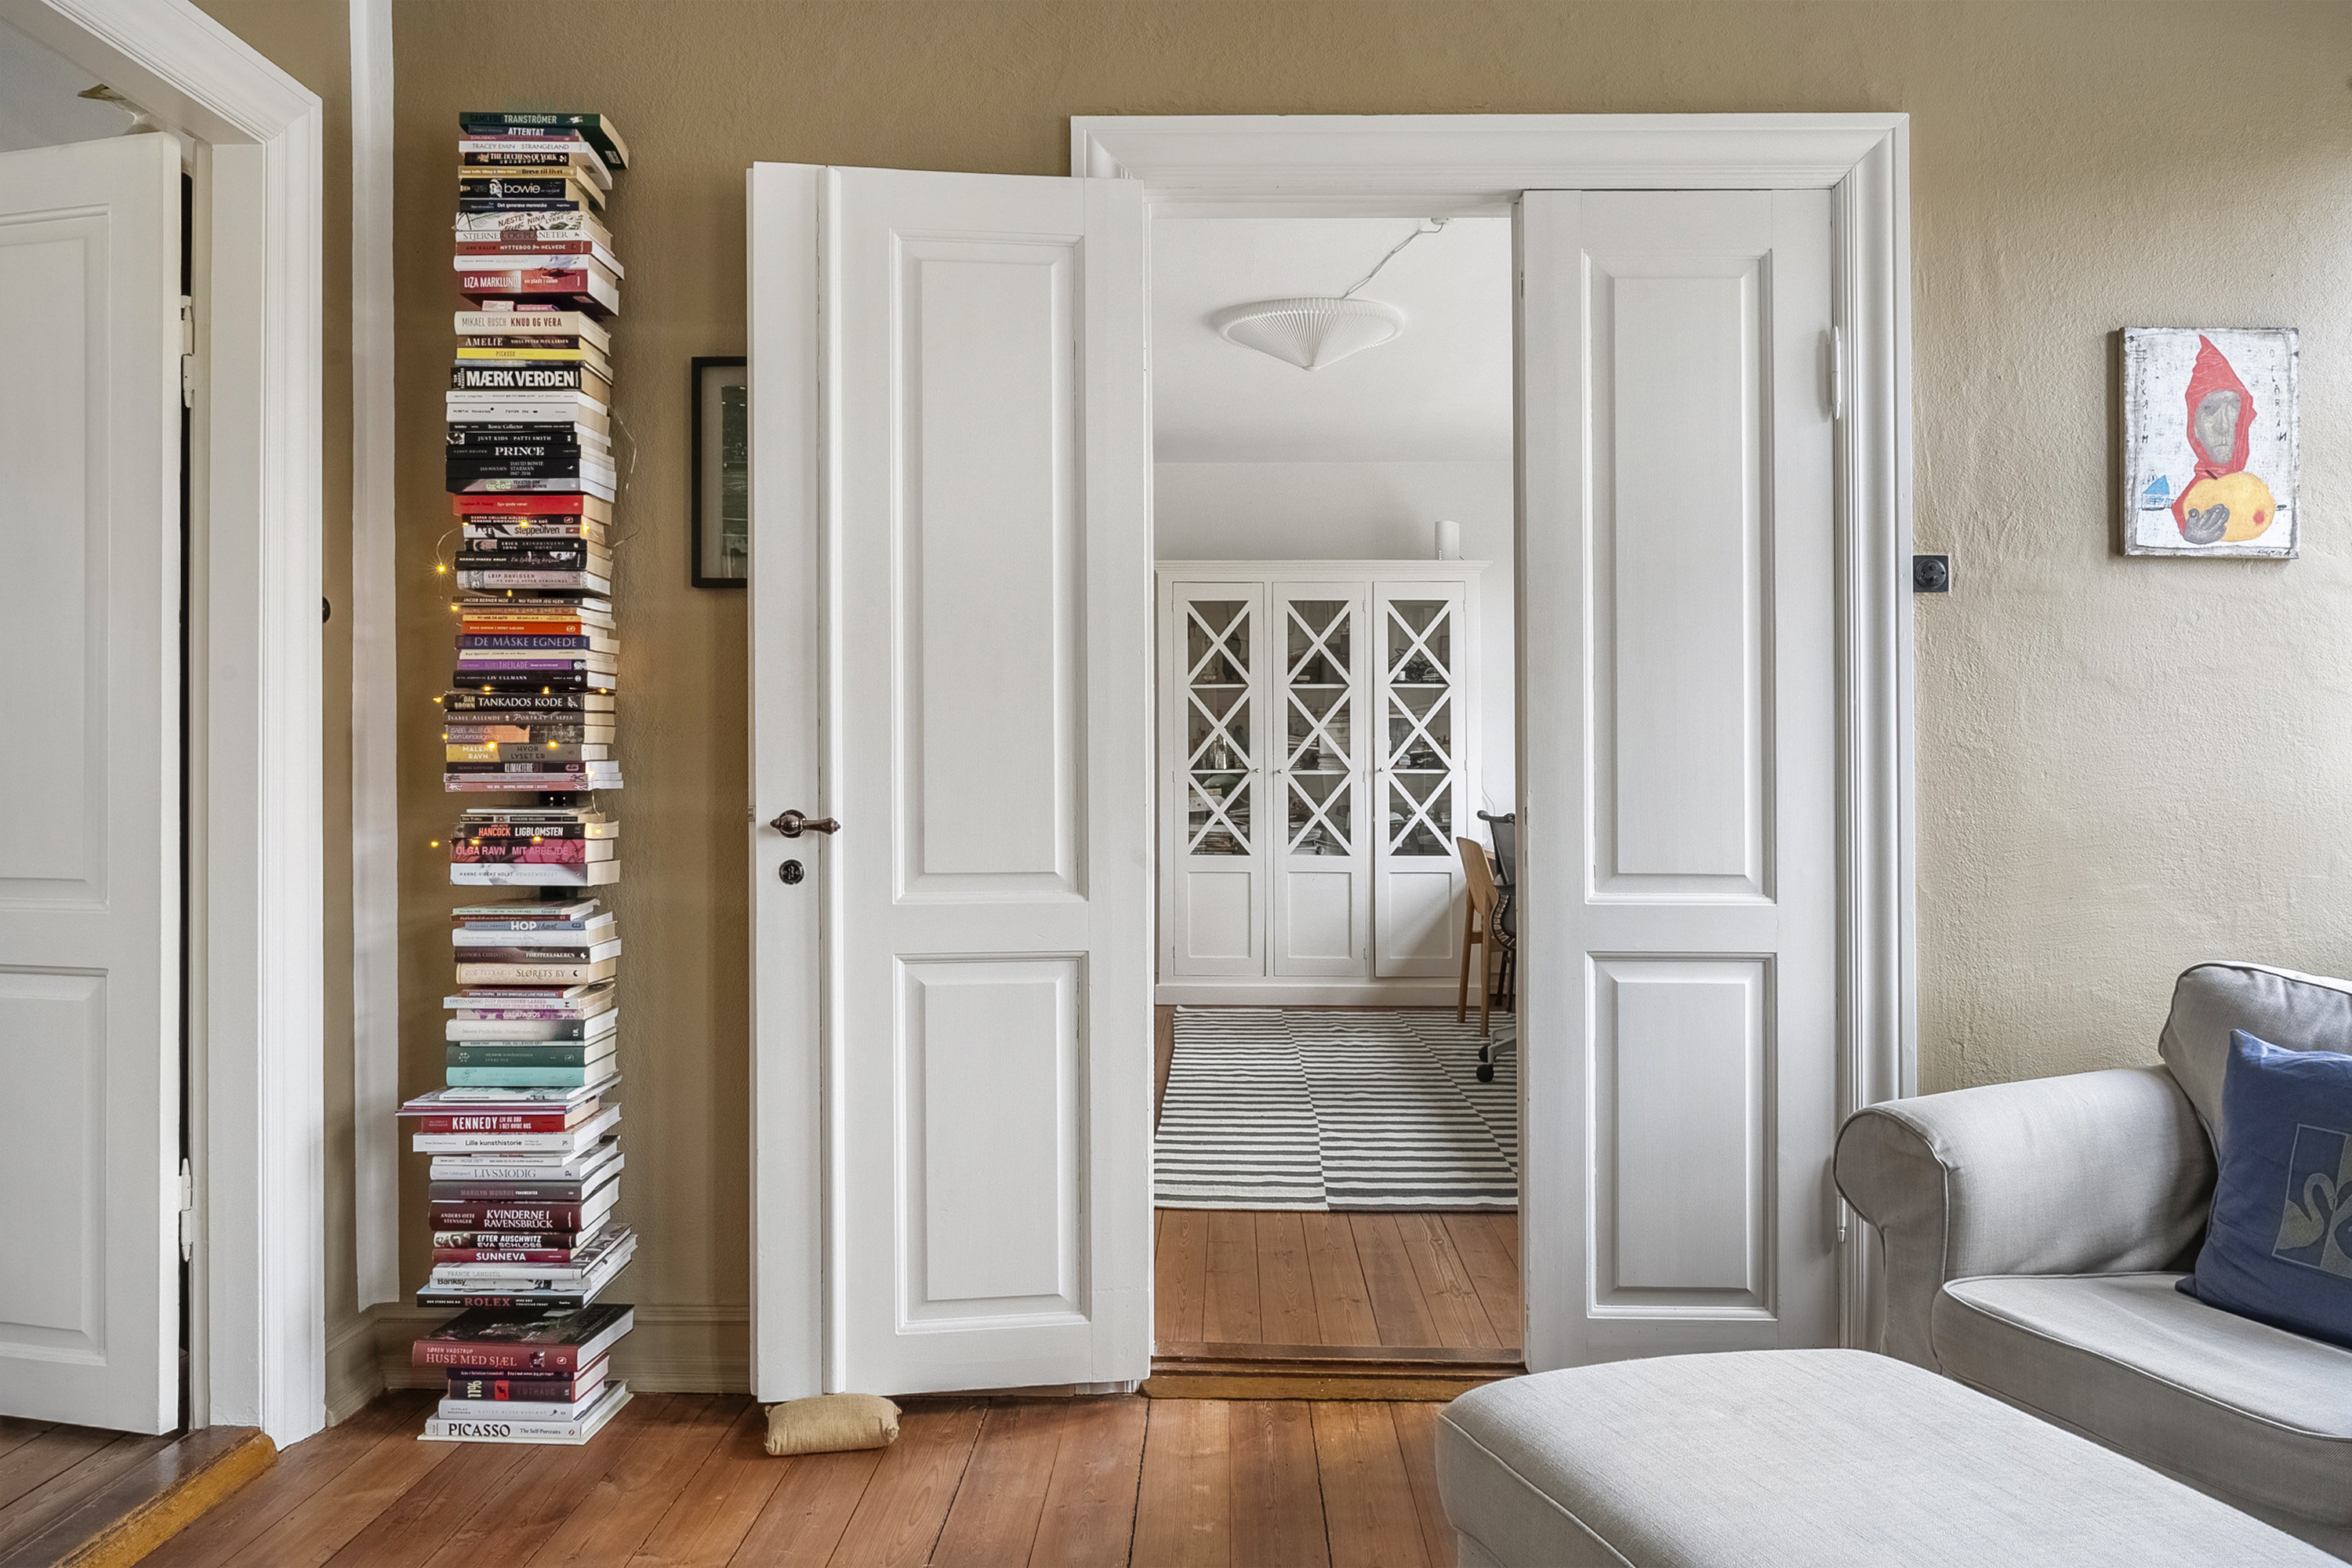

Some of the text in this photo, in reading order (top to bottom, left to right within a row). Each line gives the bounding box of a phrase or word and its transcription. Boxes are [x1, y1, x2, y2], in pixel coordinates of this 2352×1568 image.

[504, 114, 557, 124] TRANSTRÖMER
[508, 127, 545, 136] ATTENTAT
[504, 183, 541, 194] bowie
[527, 214, 546, 225] NINA
[463, 231, 568, 240] STJERNER OG PLANETER
[464, 276, 479, 288] LIZA
[480, 277, 519, 288] MARKLUND
[462, 317, 562, 327] MIKAEL BUSCH KNUD OG VERA
[465, 337, 503, 347] AMELIE
[466, 370, 515, 387] MÆRK
[514, 370, 575, 388] VERDEN
[495, 447, 545, 456] PRINCE
[514, 525, 560, 535] steppeulven
[474, 636, 577, 648] DE MÅSKE EGNEDE
[477, 697, 532, 707] TANKADOS
[535, 697, 563, 706] KODE
[478, 827, 564, 837] HANCOCK LIGBLOMSTEN
[456, 846, 568, 855] OLGA RAVN MIT ARBEJDE
[511, 921, 537, 931] HOP
[452, 1116, 499, 1131] KENNEDY
[474, 1168, 537, 1178] LIVSMODIG
[486, 1210, 546, 1219] KVINDERNE
[484, 1218, 554, 1229] RAVENSBRÜCK
[476, 1252, 527, 1261] SUNNEVA
[464, 1298, 511, 1307] ROLEX
[426, 1353, 517, 1368] HUSE MED SJÆL
[448, 1423, 510, 1437] PICASSO
